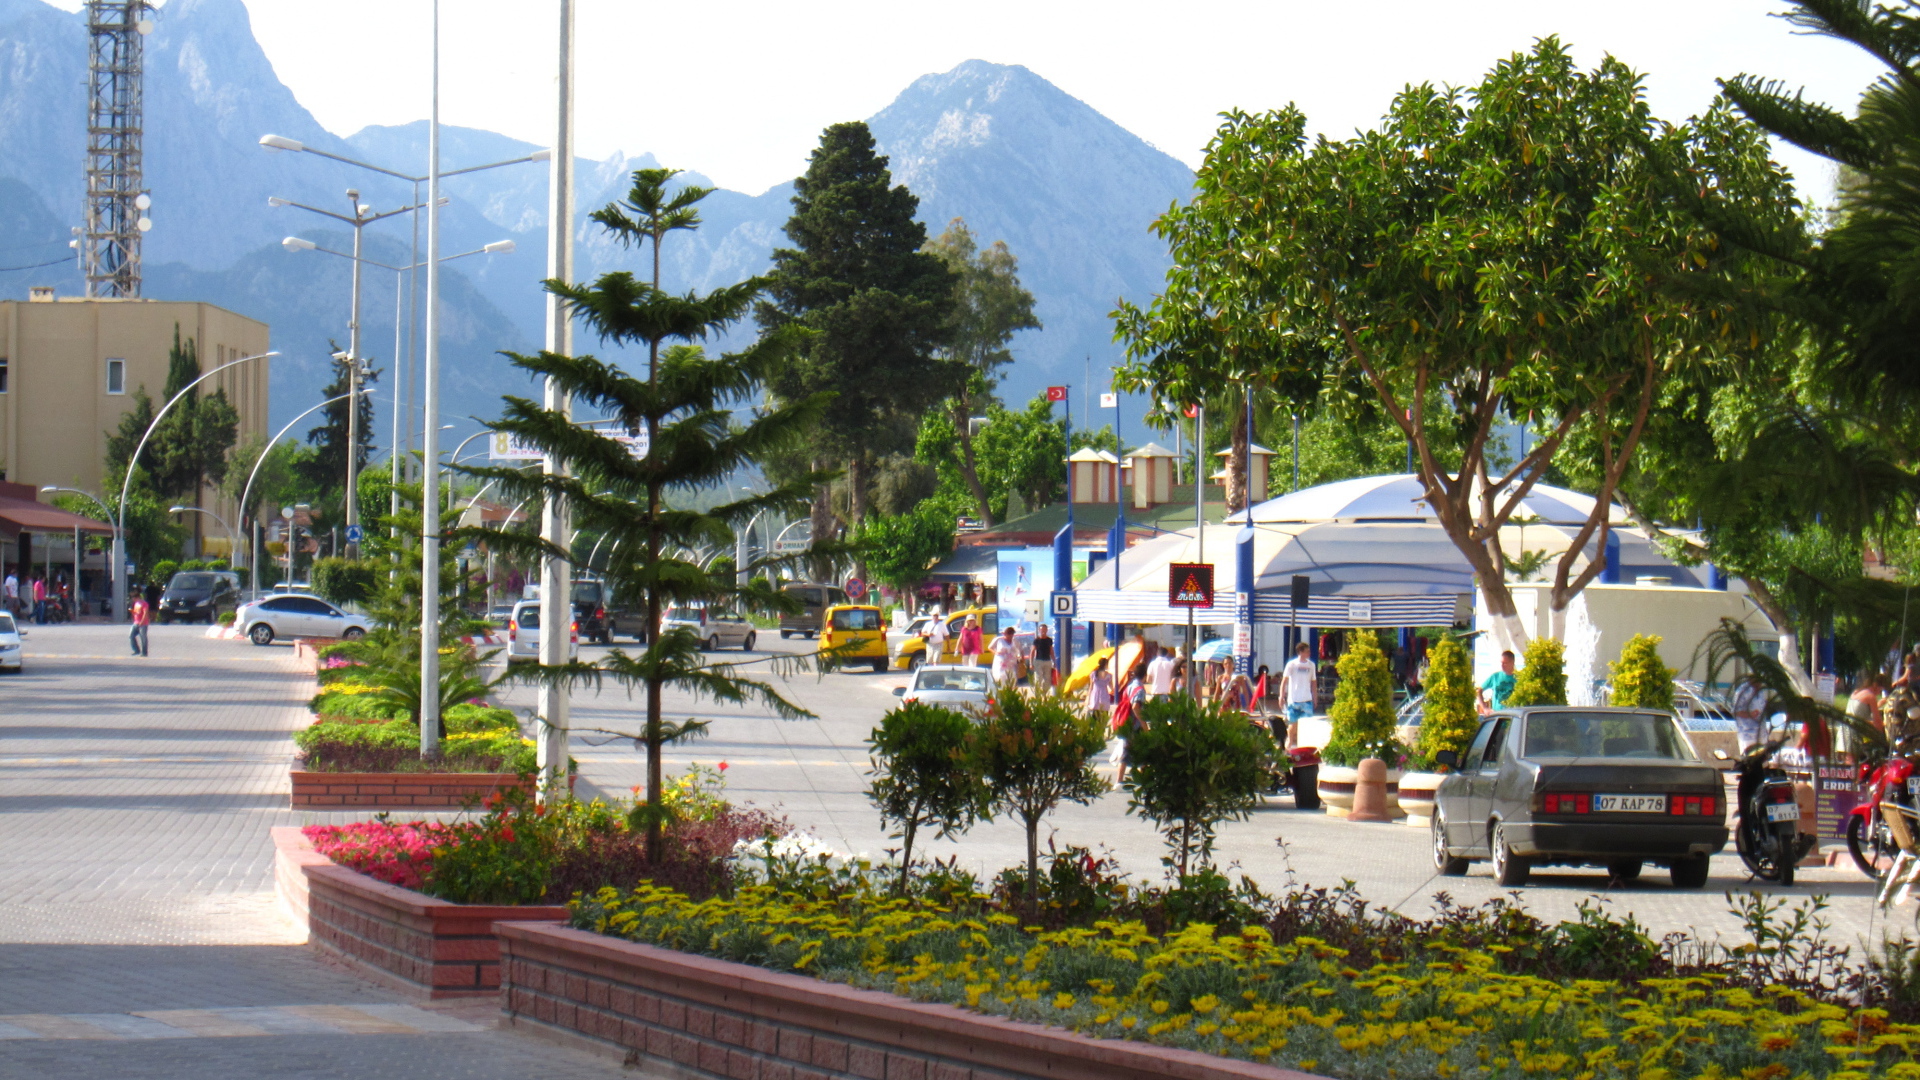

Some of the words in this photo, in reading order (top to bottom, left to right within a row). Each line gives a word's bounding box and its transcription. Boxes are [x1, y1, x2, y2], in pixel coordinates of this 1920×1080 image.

[495, 431, 508, 455] 8
[1058, 597, 1070, 611] D
[1601, 798, 1616, 809] 07
[1620, 799, 1645, 810] KAP
[1646, 799, 1663, 811] 78
